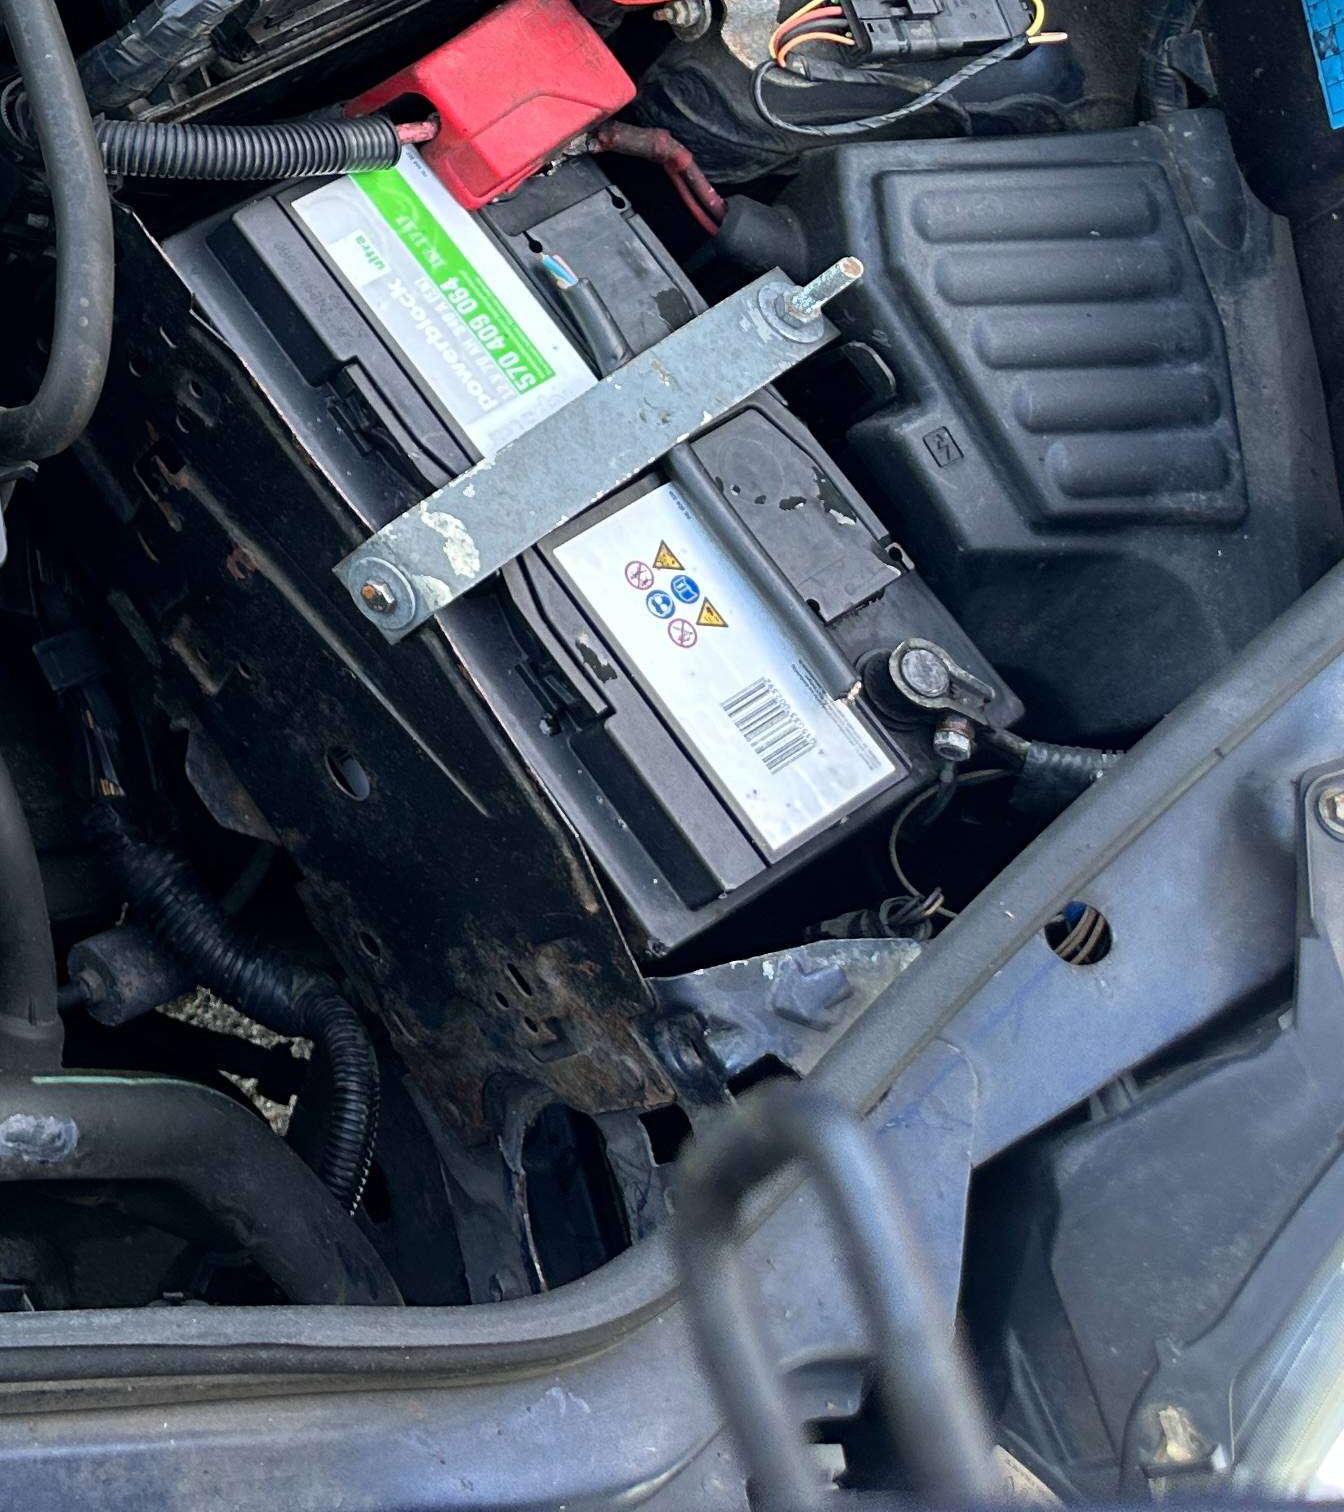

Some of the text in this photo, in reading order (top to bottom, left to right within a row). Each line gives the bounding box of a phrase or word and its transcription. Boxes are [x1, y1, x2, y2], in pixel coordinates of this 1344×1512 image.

[355, 235, 386, 270] ultra
[438, 272, 479, 318] 064
[388, 277, 493, 411] powerblock
[467, 309, 508, 355] 409
[497, 348, 538, 393] 570
